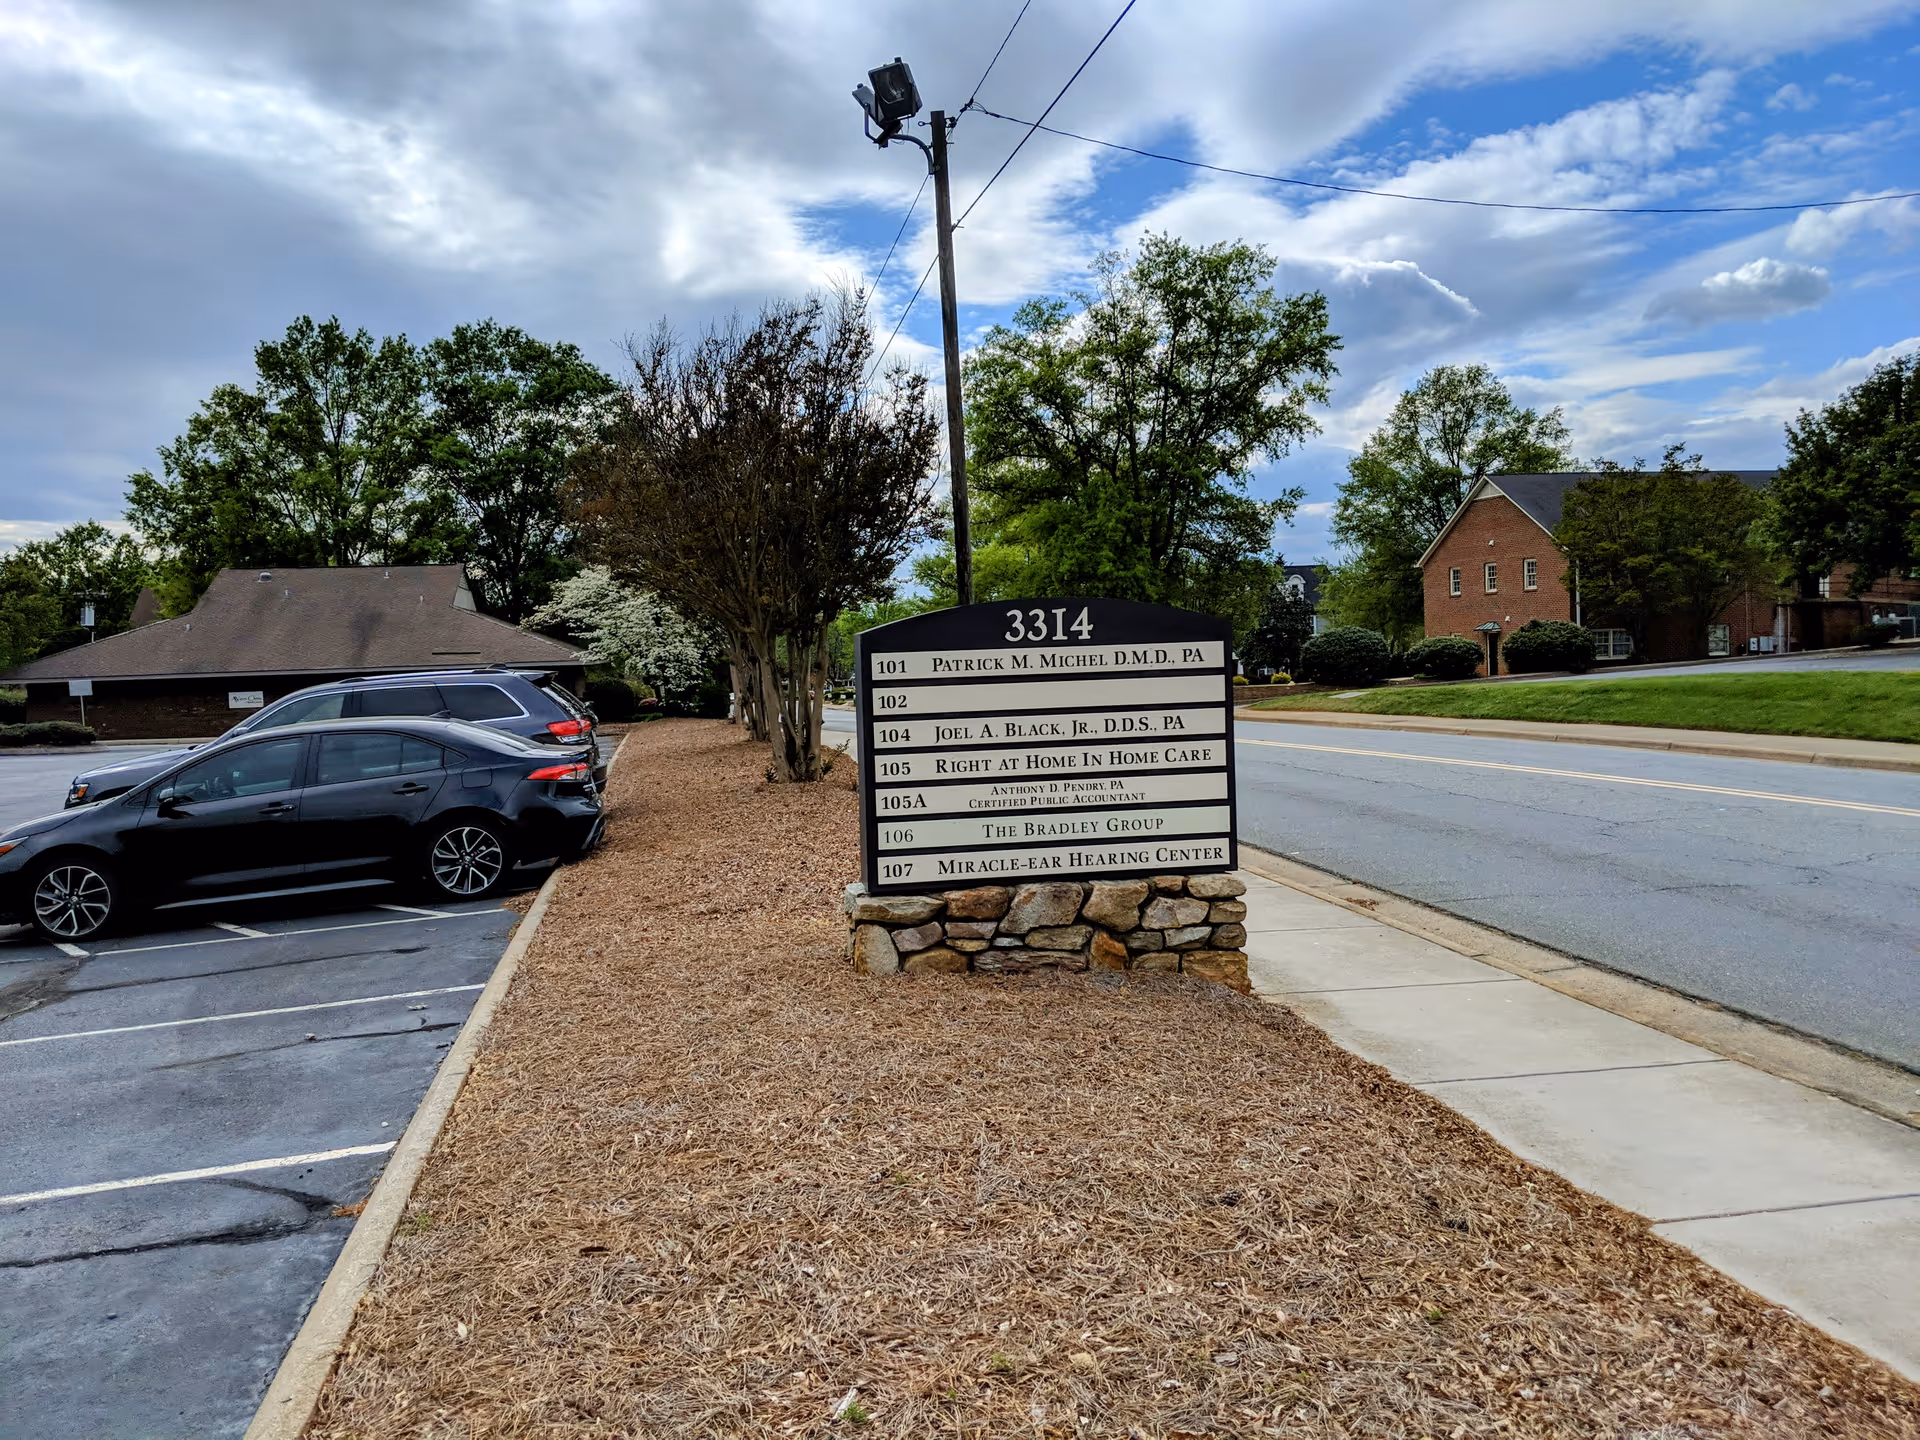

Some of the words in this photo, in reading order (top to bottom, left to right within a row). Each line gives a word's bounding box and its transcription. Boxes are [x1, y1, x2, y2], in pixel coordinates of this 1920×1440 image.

[1005, 607, 1094, 641] 3314
[877, 660, 906, 675] 101
[932, 656, 1004, 672] PATRICK
[1011, 654, 1033, 670] M.
[1039, 653, 1108, 668] MICHEL
[1181, 647, 1205, 663] PA
[878, 695, 907, 709] 102
[879, 729, 911, 743] 104
[934, 726, 973, 744] JOEL
[979, 724, 999, 738] A.
[1004, 722, 1066, 737] BLACK,
[1071, 720, 1098, 737] JR.,
[1163, 715, 1185, 730] PA
[880, 762, 911, 776] 105
[936, 758, 992, 774] RIGHT
[998, 758, 1020, 771] AT
[1025, 754, 1076, 770] HOME
[1081, 752, 1103, 767] IN
[1109, 750, 1159, 766] HOME
[1164, 747, 1212, 763] CARE
[969, 797, 1027, 809] CERTIFIED
[1030, 795, 1068, 807] PUBLIC
[1073, 792, 1146, 805] ACCOUNTANT
[990, 785, 1046, 796] ANTHONY
[1049, 782, 1060, 793] D.
[1111, 779, 1124, 790] PA
[881, 794, 927, 810] 105A
[884, 829, 914, 844] 106
[982, 823, 1017, 838] THE
[1023, 820, 1098, 837] BRADLEY
[1106, 817, 1165, 834] GROUP
[883, 863, 913, 878] 107
[937, 857, 1062, 874] MIRACLE-EAR
[1068, 851, 1150, 867] HEARING
[1155, 847, 1224, 862] CENTER
